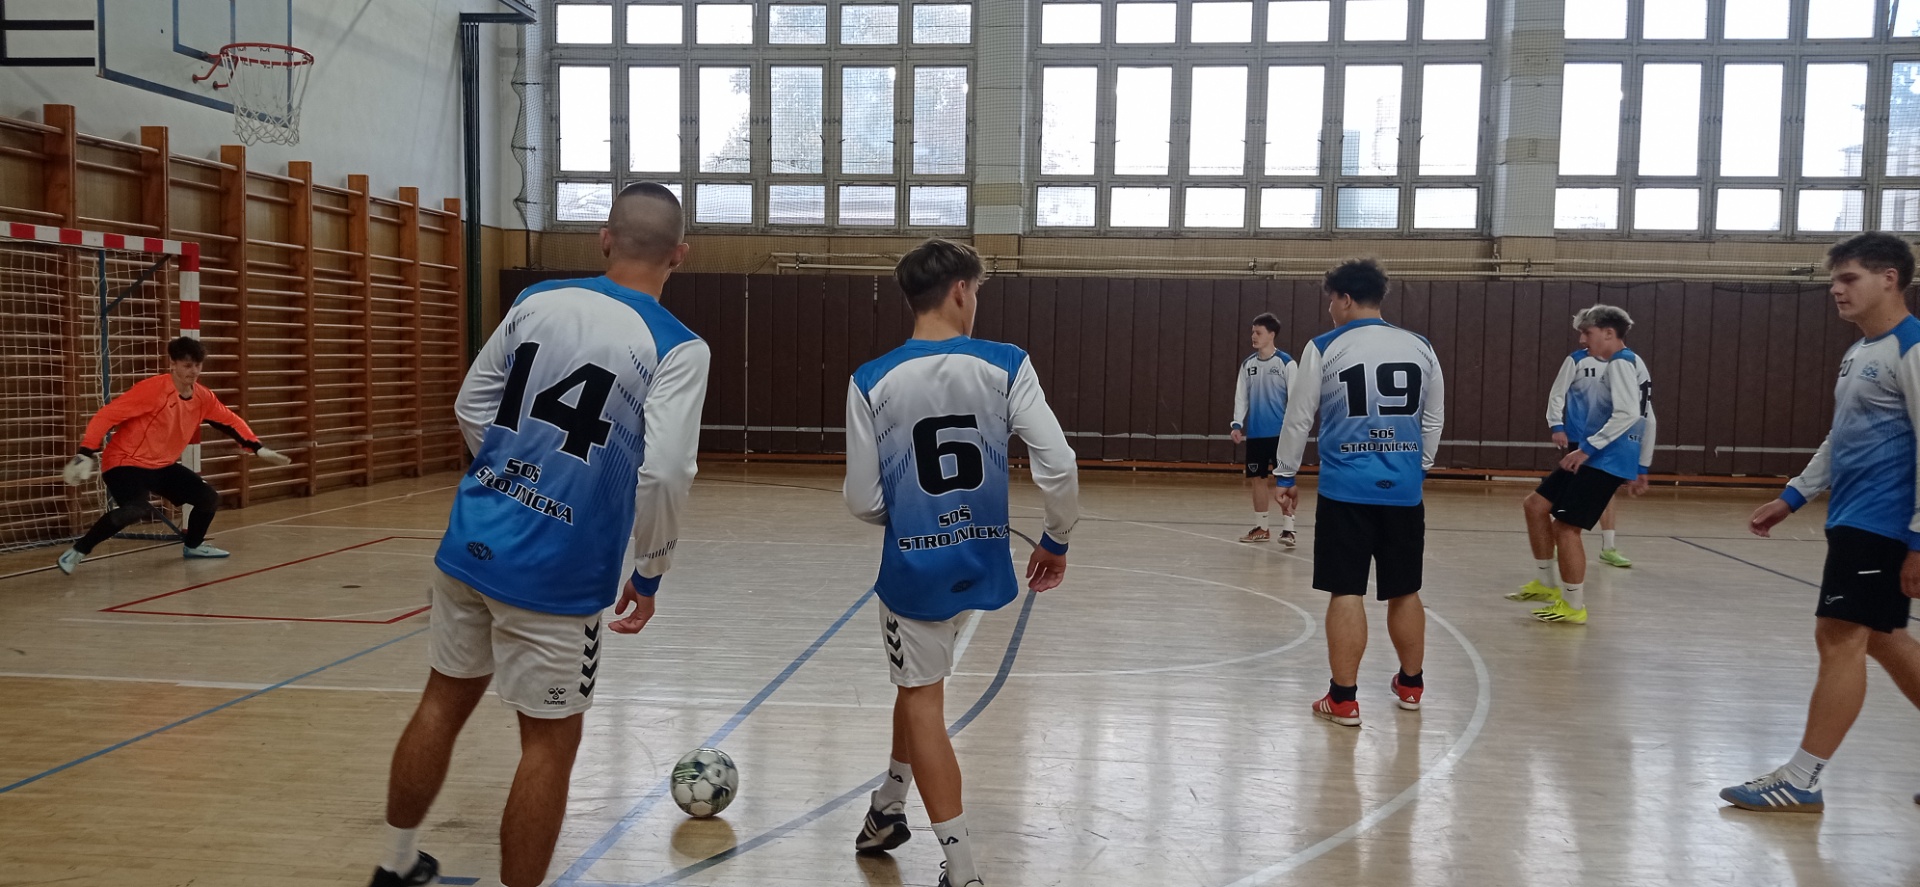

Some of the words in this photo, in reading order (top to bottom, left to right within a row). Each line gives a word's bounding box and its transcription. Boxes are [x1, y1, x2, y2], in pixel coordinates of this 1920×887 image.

[1247, 366, 1258, 376] 13
[1584, 367, 1596, 377] 11
[1338, 362, 1423, 418] 19
[493, 341, 618, 465] 14
[1369, 427, 1395, 439] SOŠ
[912, 414, 985, 497] 6
[1340, 440, 1419, 453] STROJNÍCKA
[503, 457, 543, 485] SOŠ
[938, 505, 972, 528] SOŠ
[898, 523, 1009, 552] STROJNÍCKA
